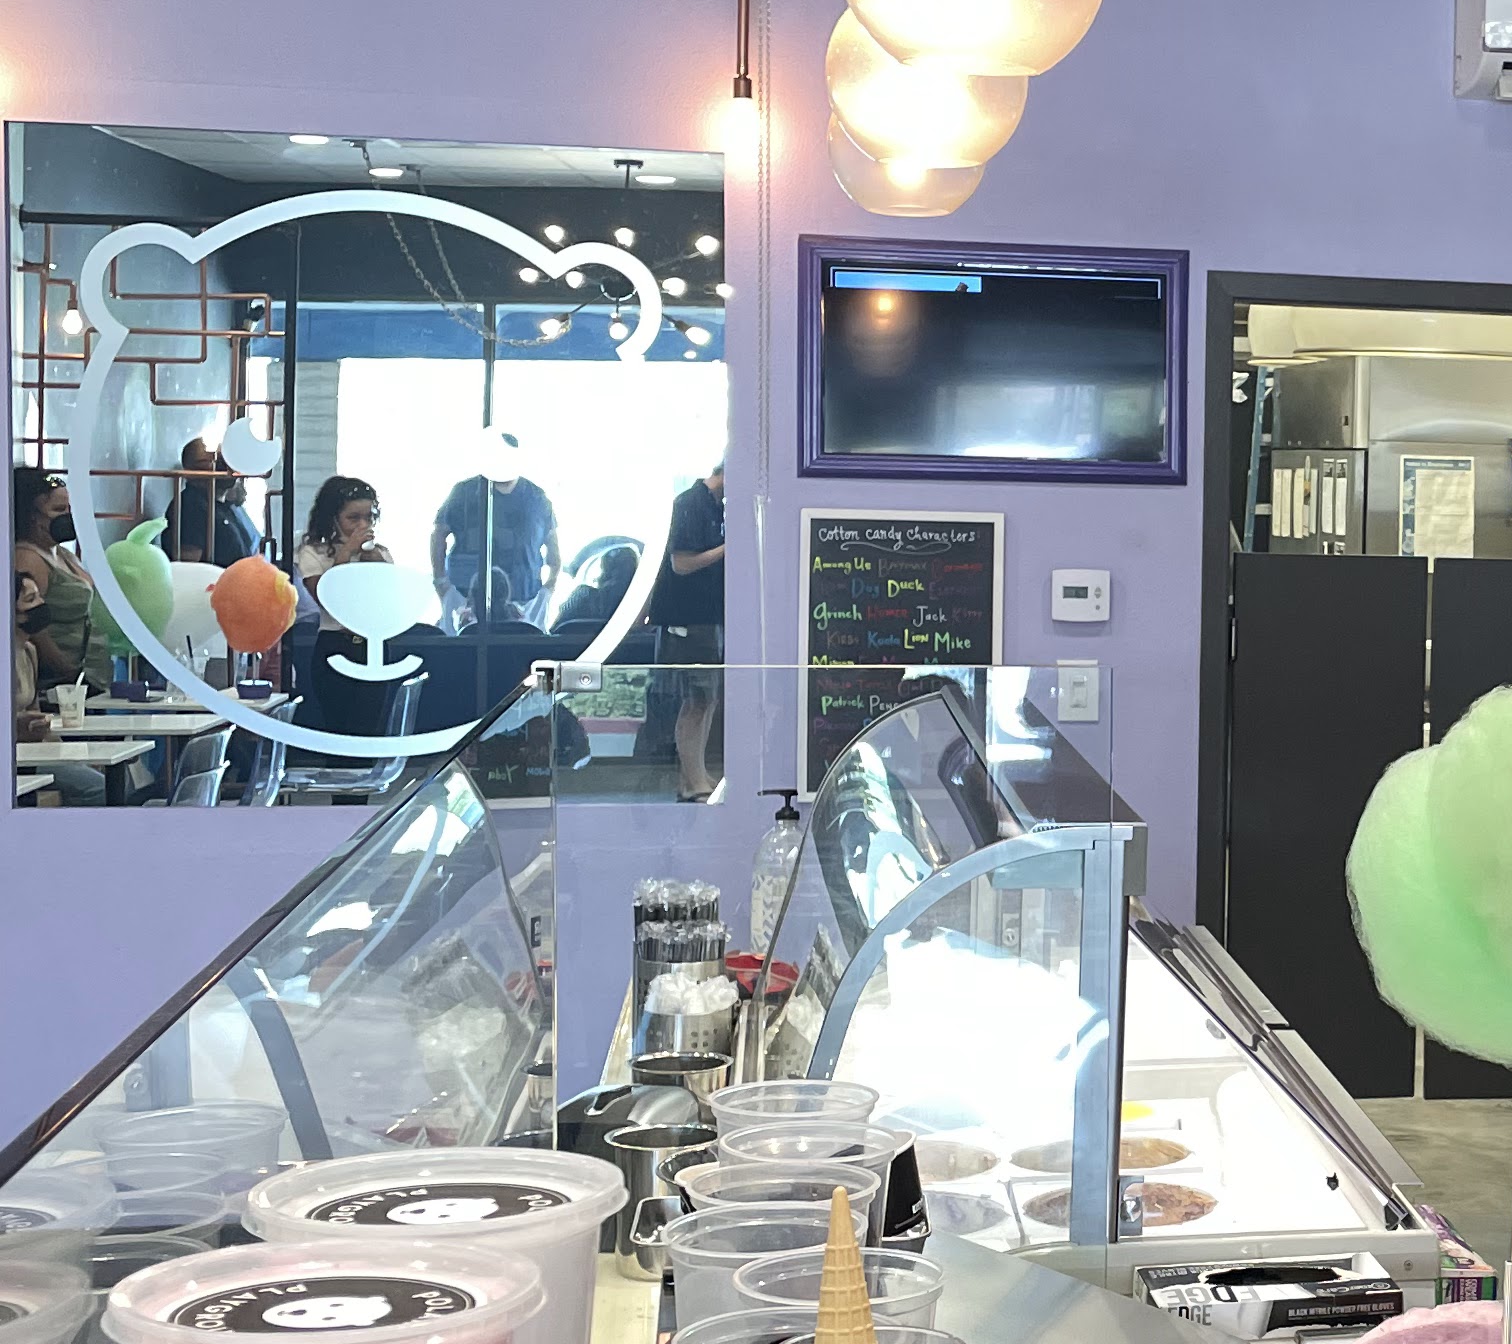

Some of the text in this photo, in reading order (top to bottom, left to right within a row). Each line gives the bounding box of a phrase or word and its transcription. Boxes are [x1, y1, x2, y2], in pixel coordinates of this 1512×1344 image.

[812, 555, 852, 575] Among
[887, 578, 925, 598] Duck
[912, 605, 948, 627] Jack
[933, 631, 972, 653] Mike
[1287, 1307, 1310, 1322] BLACK
[1371, 1302, 1395, 1315] GLOVES
